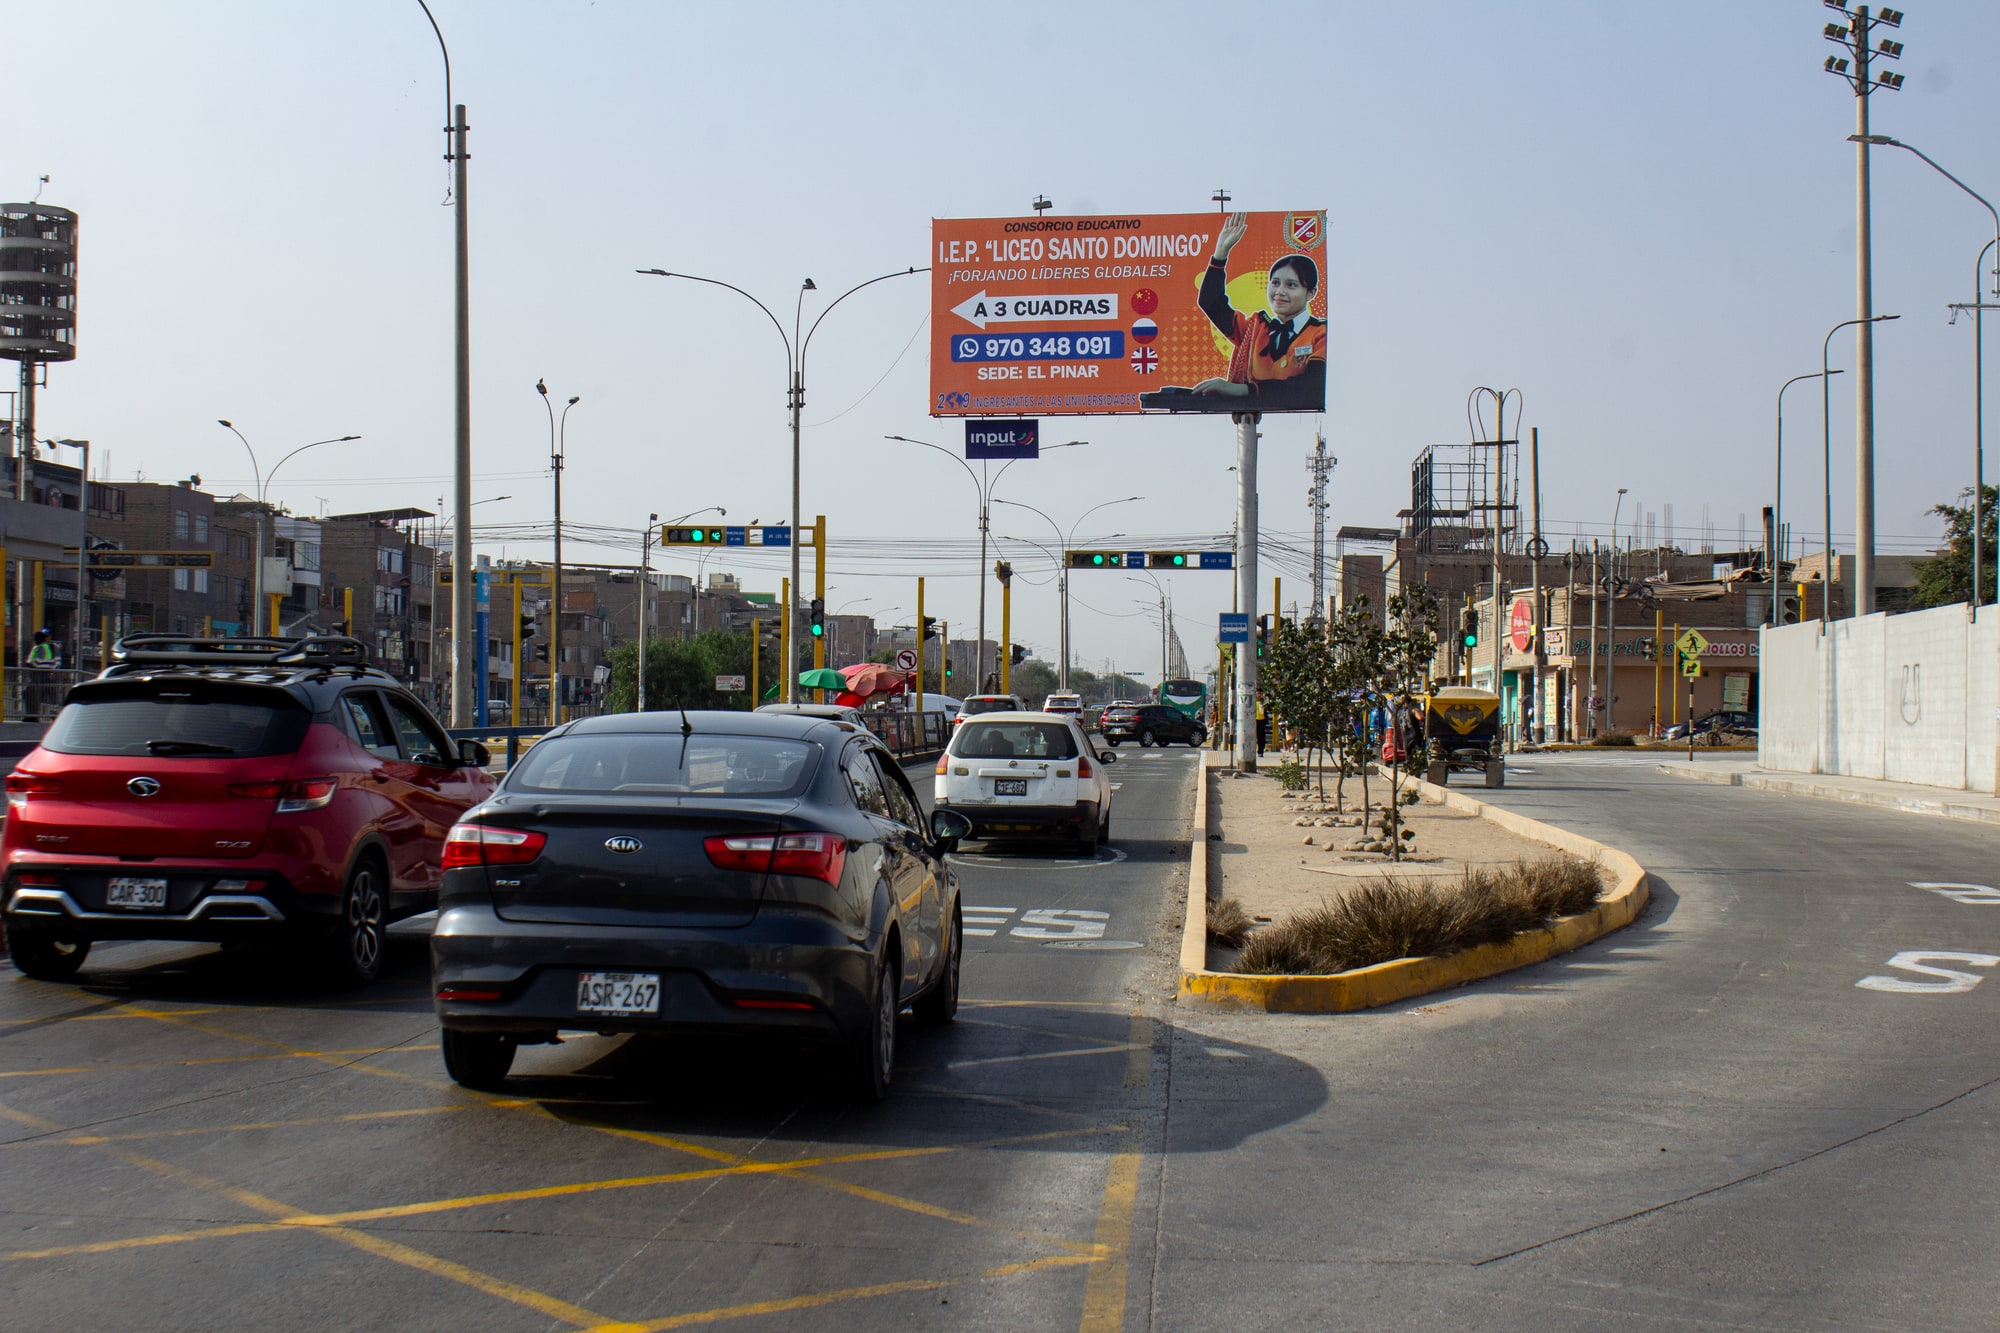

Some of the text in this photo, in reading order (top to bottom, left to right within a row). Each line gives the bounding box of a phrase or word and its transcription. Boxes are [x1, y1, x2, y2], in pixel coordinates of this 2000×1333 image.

[1004, 219, 1142, 233] CONSORCIO EDUCATIVO
[939, 240, 980, 263] I.E.P.
[1047, 236, 1109, 261] SANTO
[948, 264, 1171, 285] ¡FORJANDO LÍDERES GLOBALES!
[973, 299, 1110, 317] A 3 CUADRAS
[985, 336, 1111, 358] 970 348 091
[976, 364, 1099, 380] SEDE: EL PINAR
[973, 396, 1035, 409] INGRESANTES
[1037, 396, 1044, 407] A
[1046, 395, 1062, 407] LAS
[1065, 394, 1137, 407] UNIVERSIDADES
[970, 430, 1016, 446] input
[609, 838, 638, 851] KIA
[109, 885, 164, 904] CAR-300
[579, 981, 658, 1009] ASR-267
